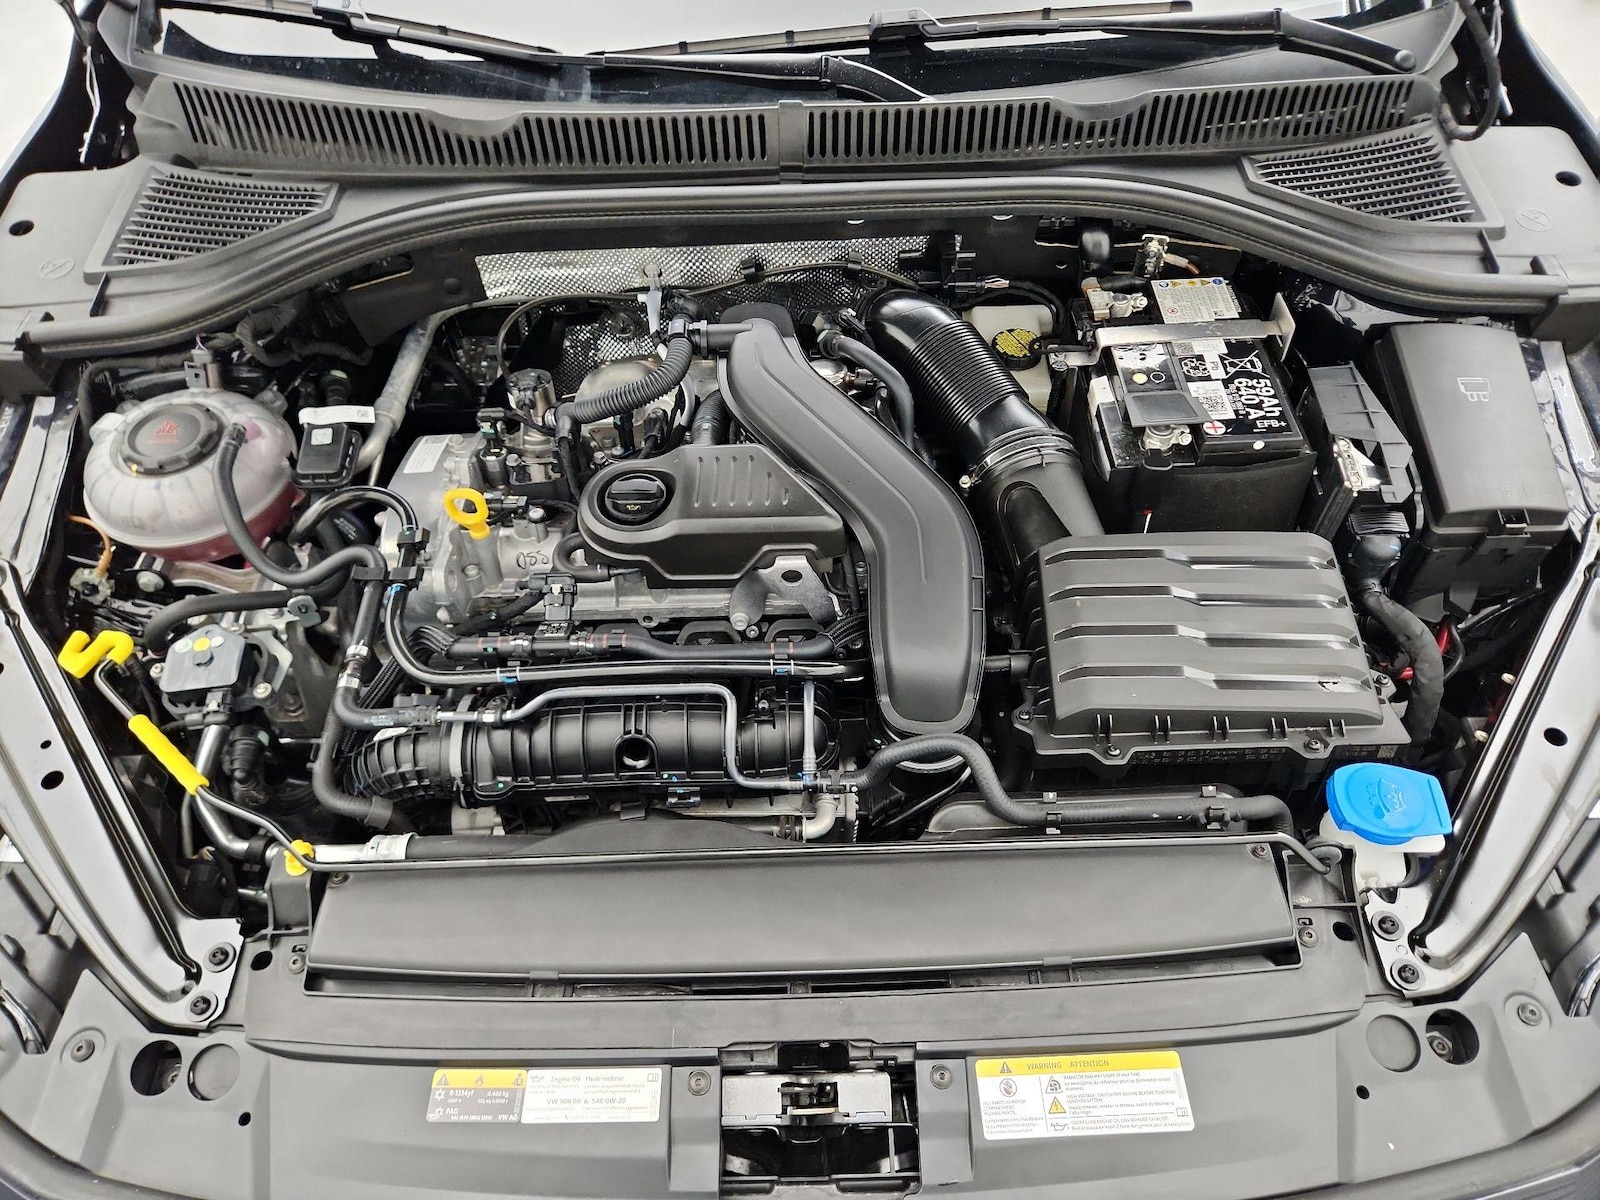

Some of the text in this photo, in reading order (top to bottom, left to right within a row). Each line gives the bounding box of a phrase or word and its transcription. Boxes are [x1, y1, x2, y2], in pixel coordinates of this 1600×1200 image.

[1210, 361, 1218, 371] Pb
[1234, 378, 1260, 404] 640
[1252, 379, 1282, 417] 59Ah
[1245, 407, 1266, 420] A
[1256, 419, 1287, 428] EFB+
[1027, 1060, 1110, 1070] WARNING ATTENTION
[448, 1090, 474, 1099] R-1234yf
